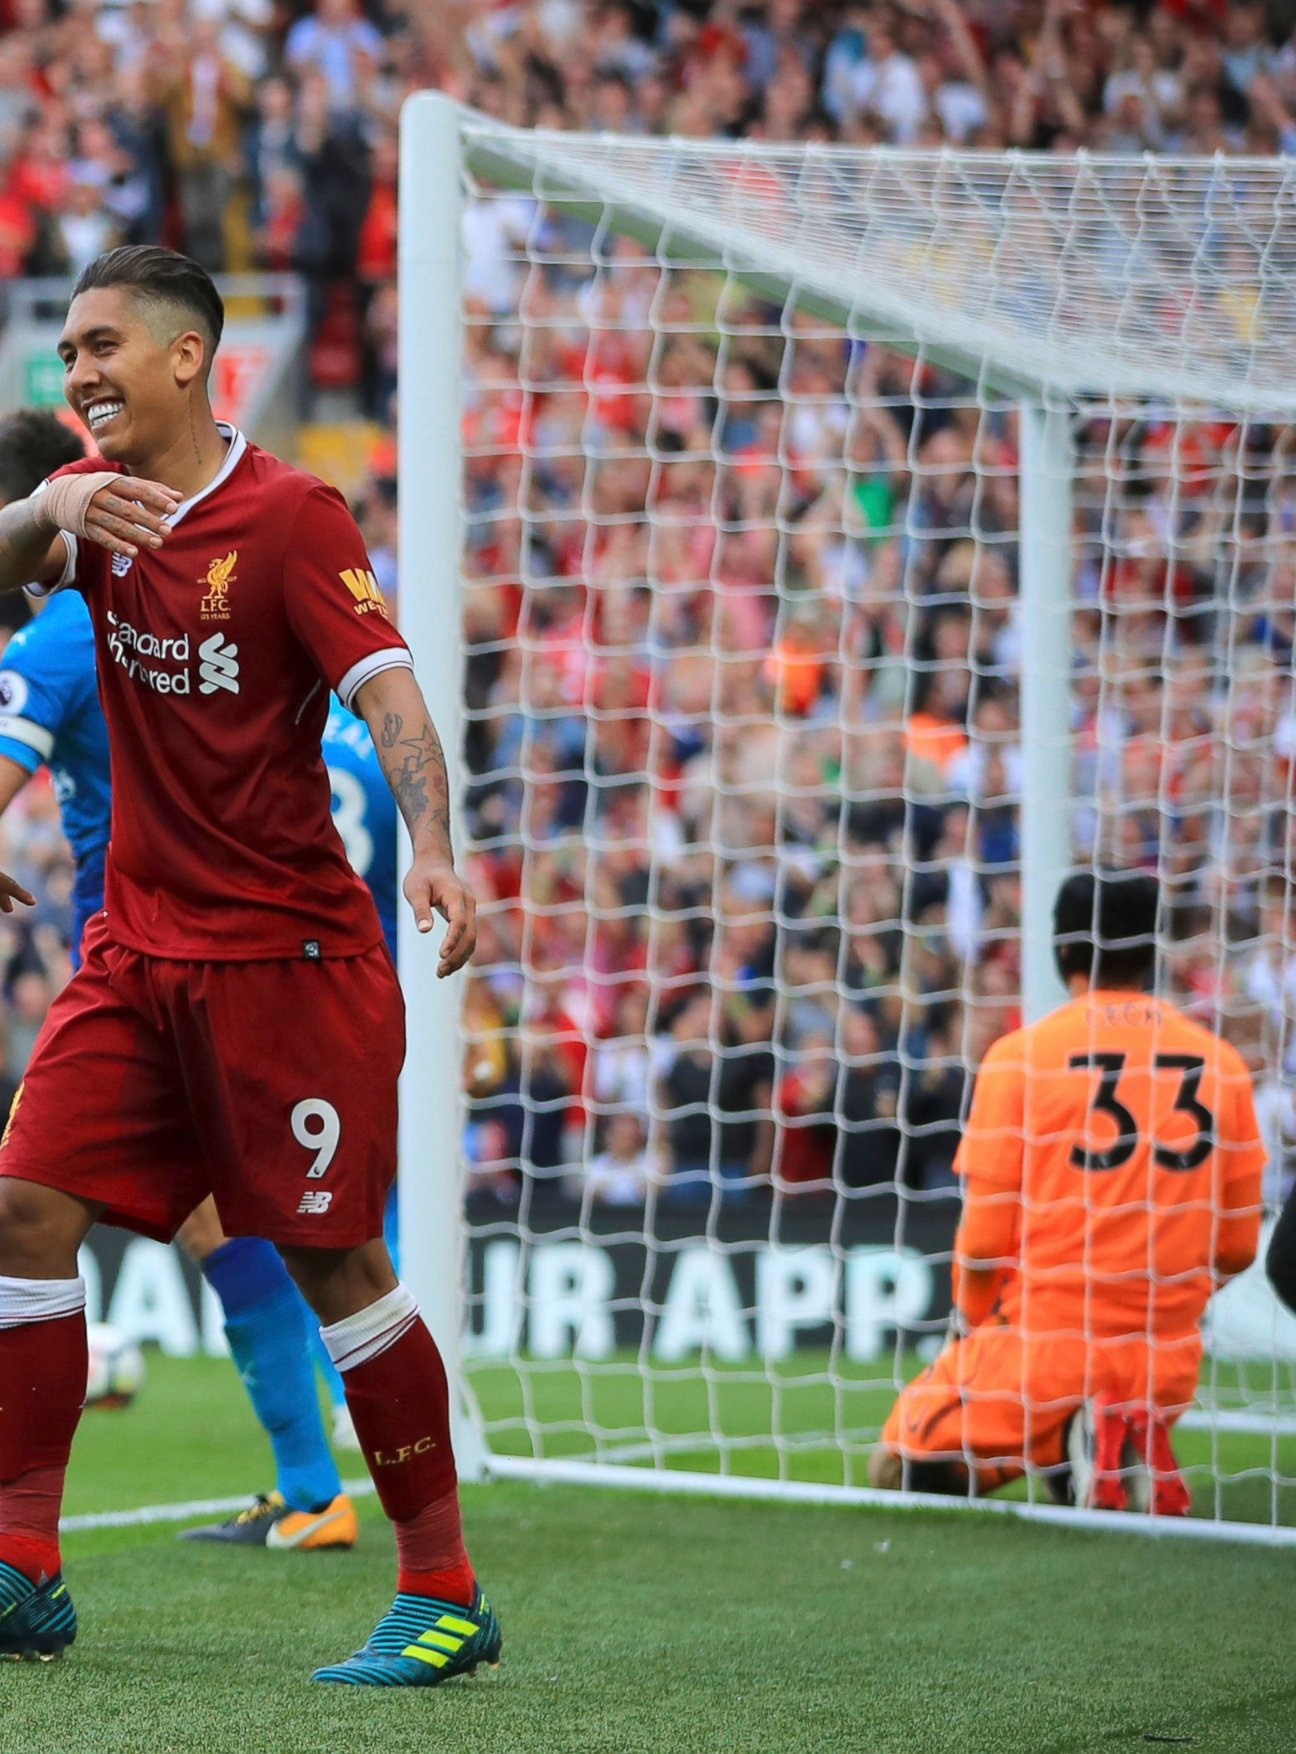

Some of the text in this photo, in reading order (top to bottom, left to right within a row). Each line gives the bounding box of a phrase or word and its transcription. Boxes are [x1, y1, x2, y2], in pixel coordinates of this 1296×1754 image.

[200, 599, 231, 612] L.F.C.
[290, 1098, 341, 1178] 9
[1069, 1053, 1214, 1170] 33
[373, 1436, 436, 1466] L.F.C.
